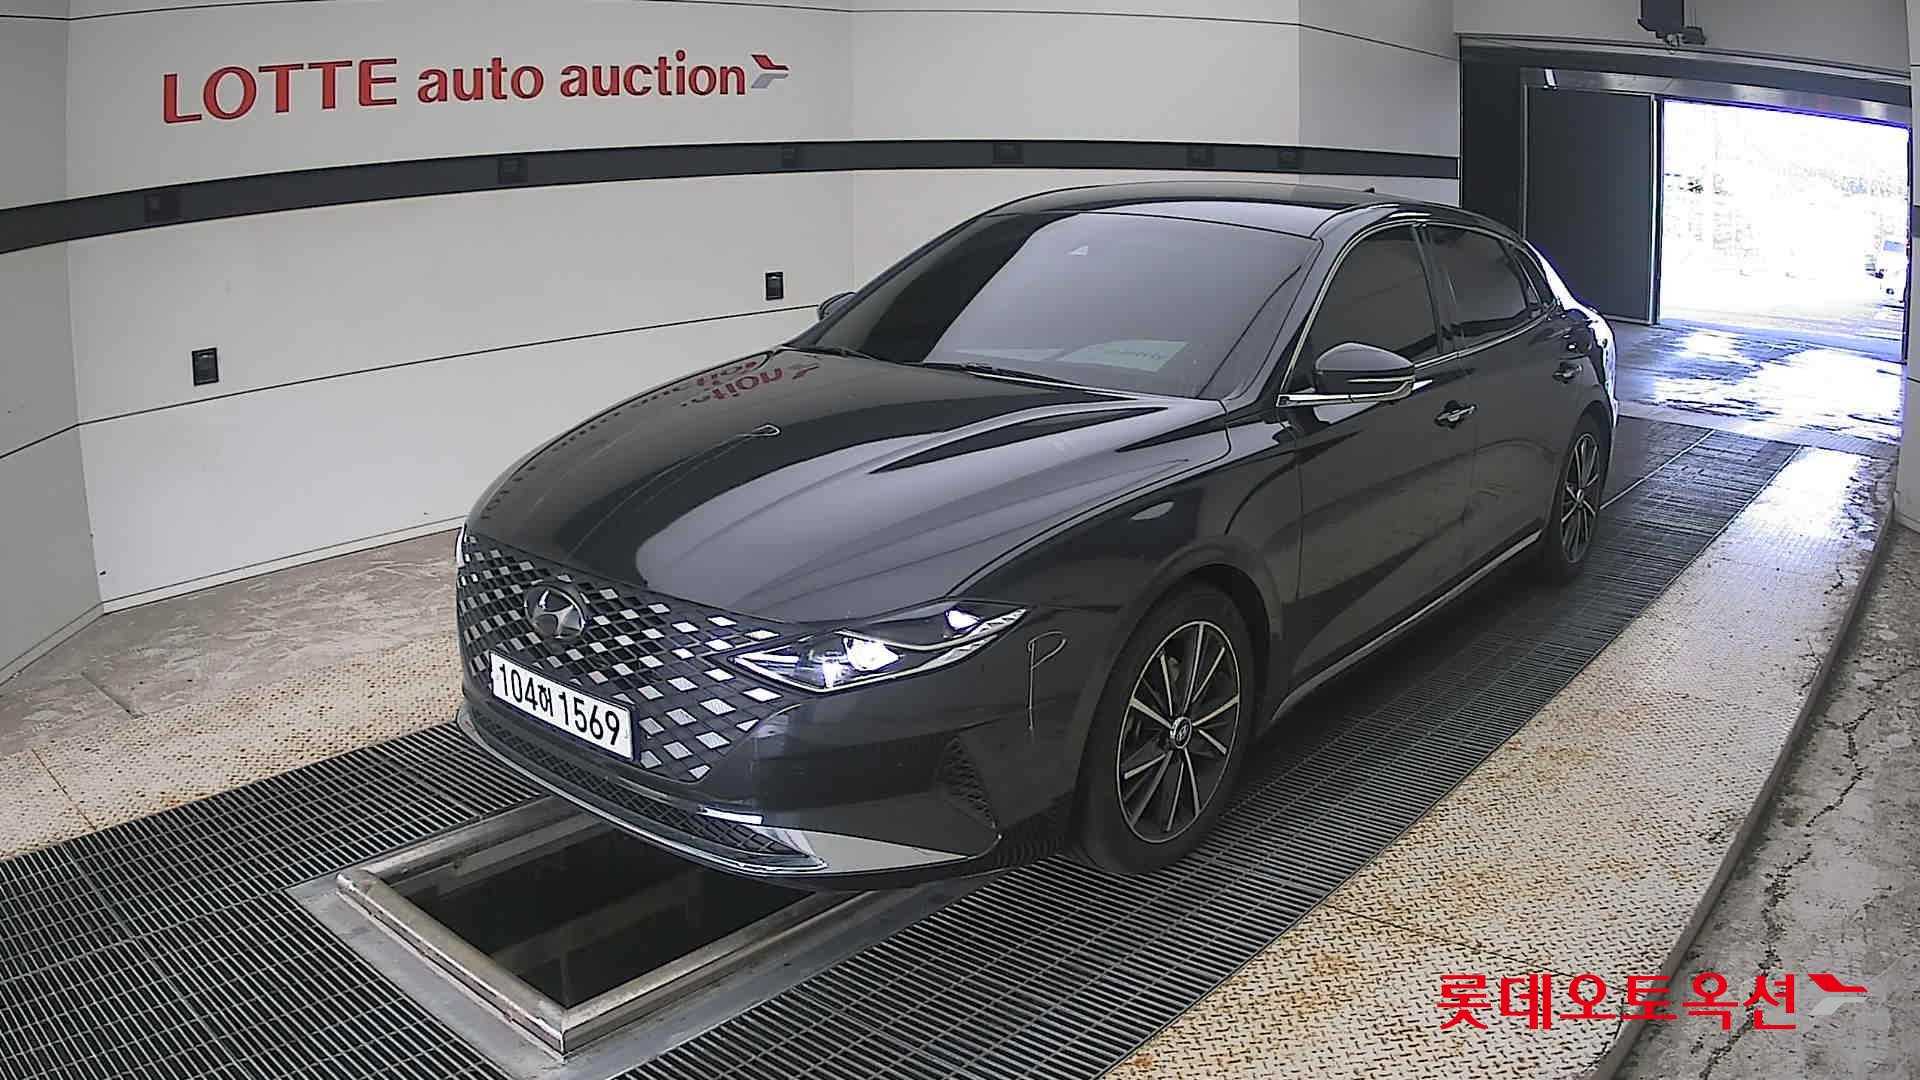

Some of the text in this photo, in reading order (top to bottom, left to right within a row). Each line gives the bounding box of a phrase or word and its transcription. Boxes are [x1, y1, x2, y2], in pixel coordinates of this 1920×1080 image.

[163, 50, 746, 124] LOTTE auto auction
[499, 663, 620, 746] 104허 1569
